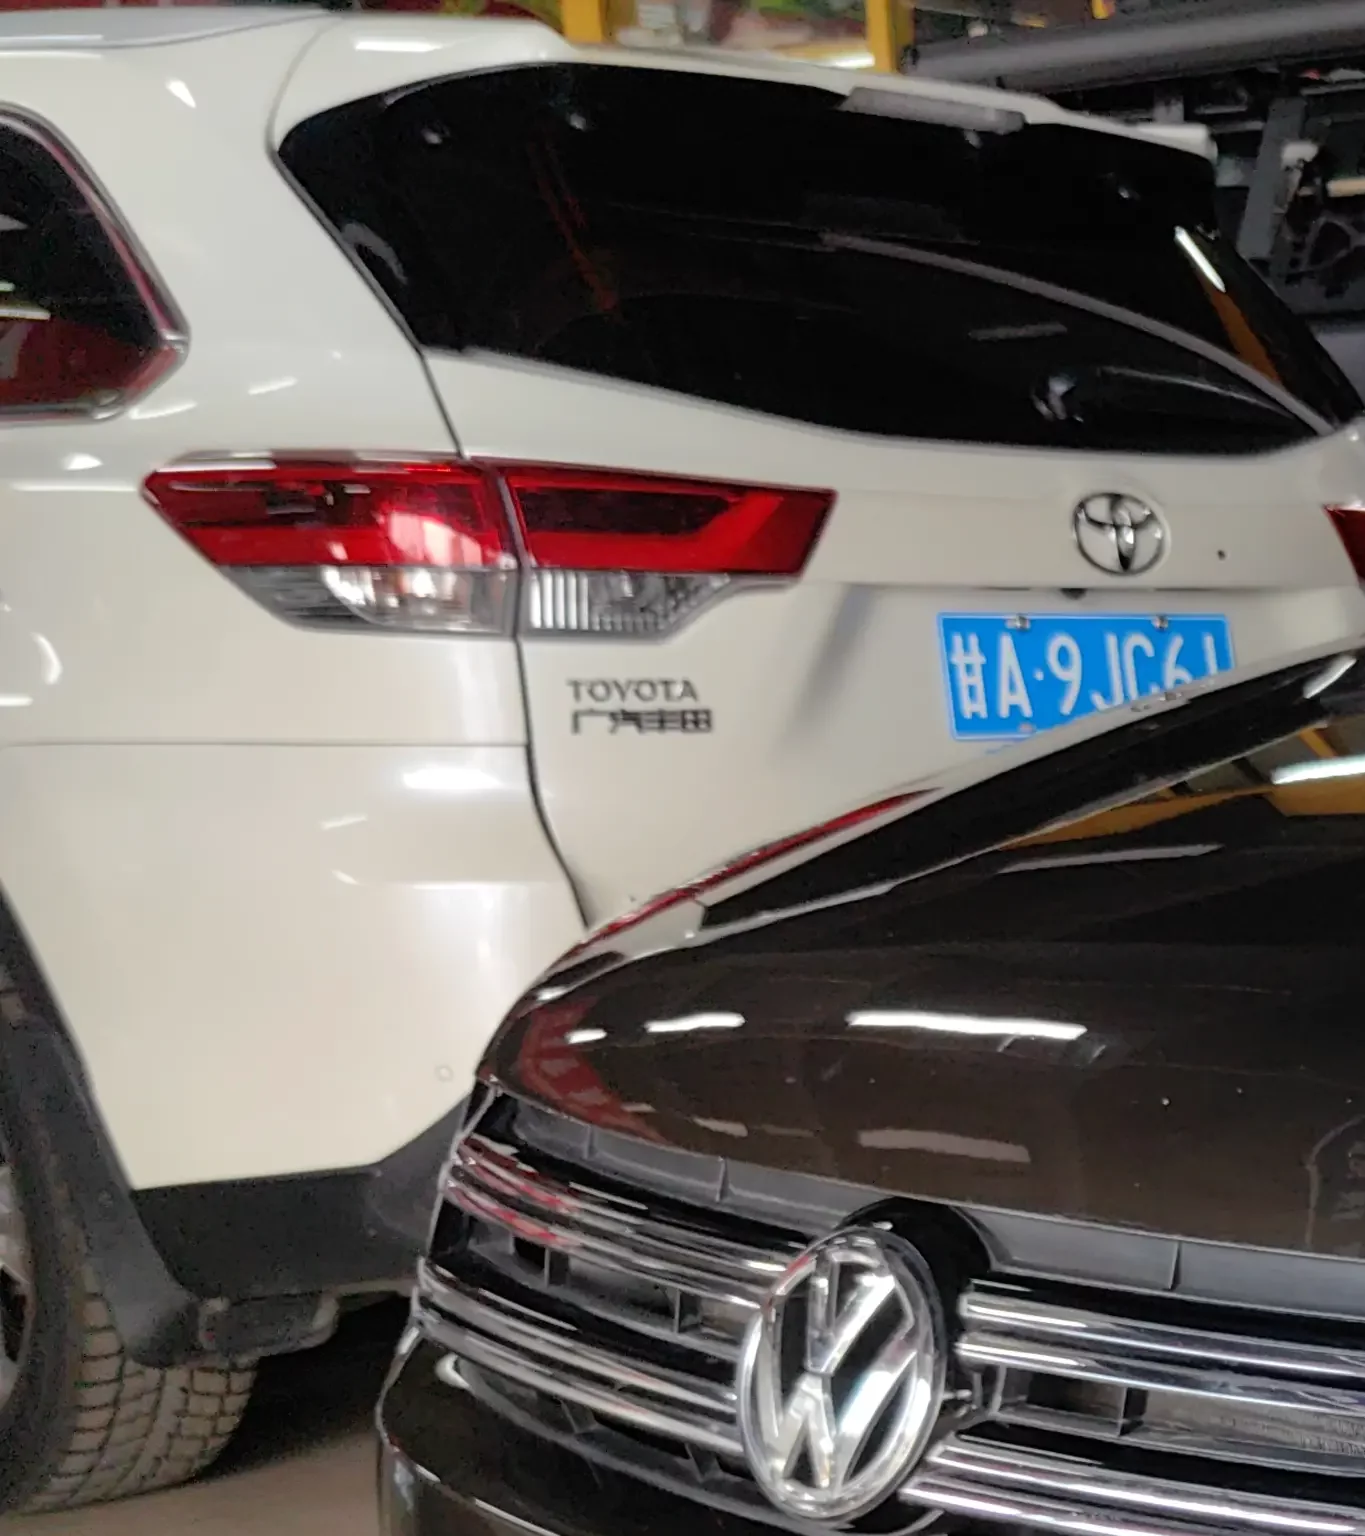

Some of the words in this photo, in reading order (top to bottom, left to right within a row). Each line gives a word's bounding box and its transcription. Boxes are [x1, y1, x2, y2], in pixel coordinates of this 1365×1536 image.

[566, 677, 699, 702] TOYOTA
[572, 708, 713, 735] 广汽丰田
